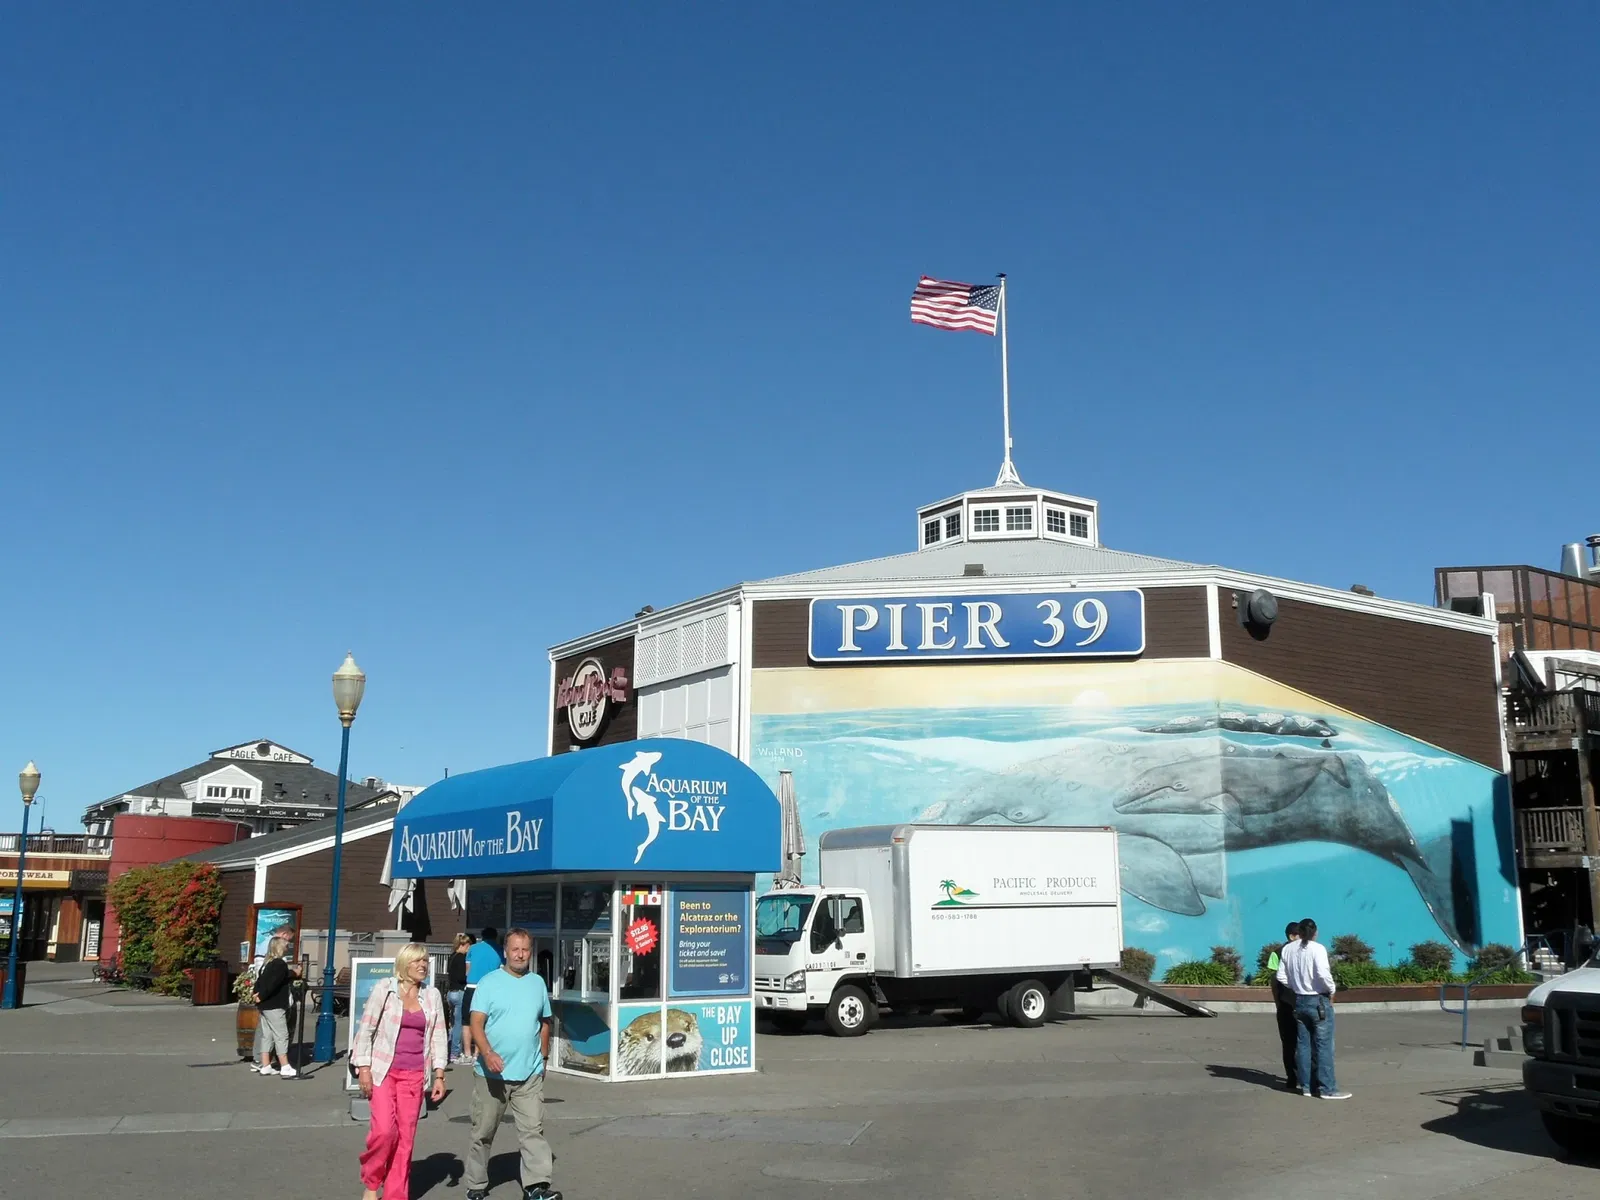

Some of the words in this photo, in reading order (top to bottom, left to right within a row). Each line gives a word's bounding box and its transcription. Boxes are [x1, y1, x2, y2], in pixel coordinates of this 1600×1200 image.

[836, 600, 1010, 652] PIER
[1033, 598, 1109, 648] 39
[230, 749, 256, 760] EAGLE
[273, 752, 293, 762] CAFE
[646, 773, 728, 798] AQUARIUM
[690, 795, 702, 804] OF
[703, 795, 720, 804] THE
[667, 800, 726, 832] BAY
[398, 825, 474, 873] AQUARIUM
[473, 840, 486, 857] OF
[487, 838, 505, 856] THE
[505, 810, 544, 854] BAY
[993, 876, 1037, 889] PACIFIC
[1046, 876, 1097, 889] PRODUCE
[680, 901, 700, 910] Been
[702, 902, 711, 910] to
[680, 913, 713, 922] Alcatraz
[724, 913, 738, 921] the
[680, 925, 742, 935] Exploratorium?
[679, 940, 696, 950] Bring
[696, 941, 711, 949] your
[679, 949, 697, 957] ticket
[697, 949, 710, 957] and
[702, 1006, 715, 1018] THE
[717, 1005, 742, 1025] BAY
[721, 1027, 738, 1045] UP
[710, 1046, 749, 1067] CLOSE
